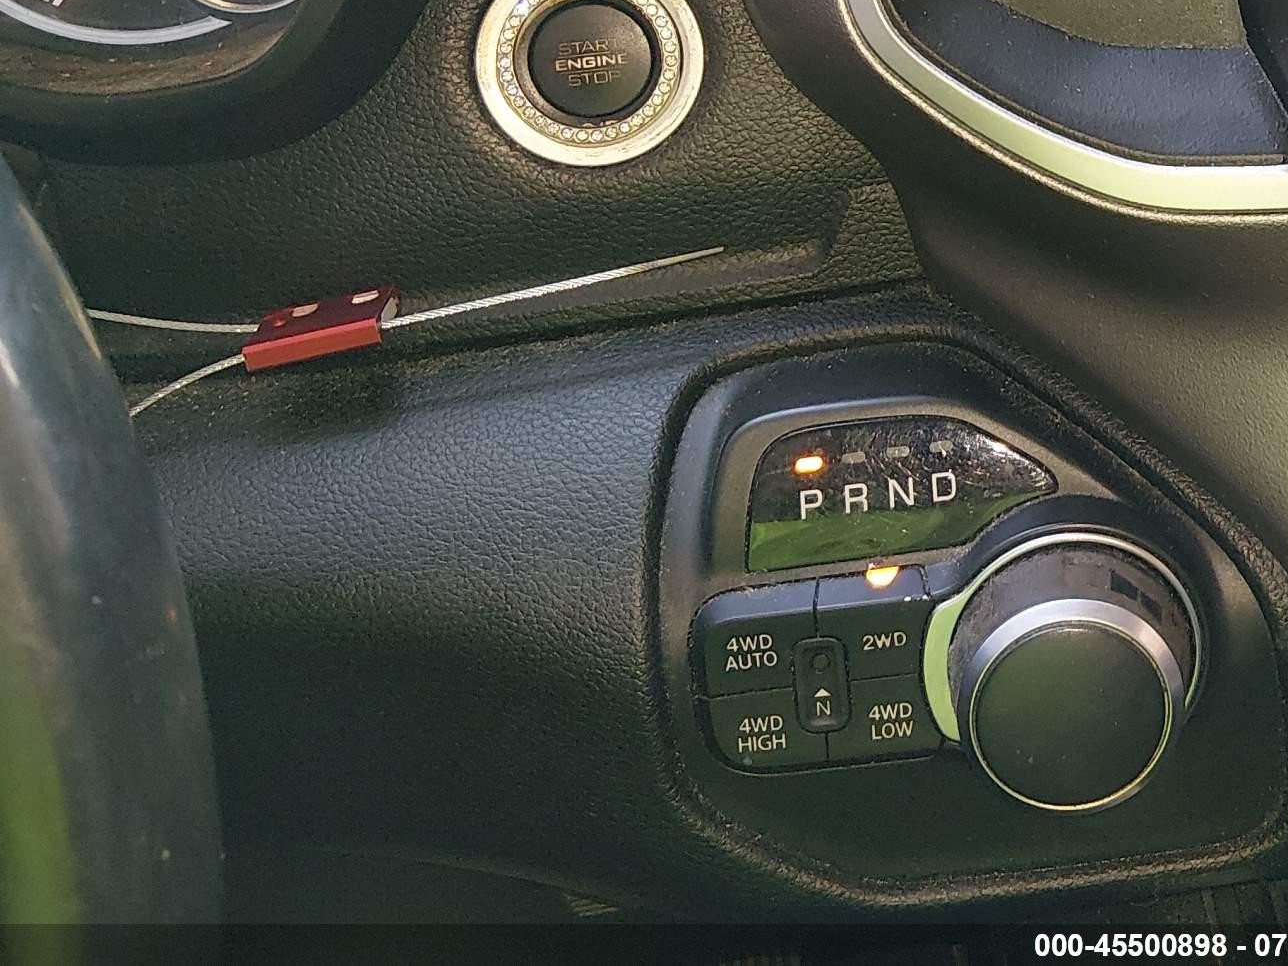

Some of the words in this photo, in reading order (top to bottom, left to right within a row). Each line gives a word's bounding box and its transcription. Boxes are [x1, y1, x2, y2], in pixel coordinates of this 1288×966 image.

[555, 52, 629, 72] ENGINE
[568, 69, 623, 88] STOP
[800, 489, 824, 520] P
[844, 483, 869, 515] R
[888, 476, 914, 509] N
[931, 471, 957, 504] D
[726, 634, 774, 652] 4WD
[862, 631, 907, 651] 2WD
[725, 650, 778, 672] AUTO
[816, 699, 831, 716] N
[868, 701, 913, 722] 4WD
[738, 714, 783, 734] 4WD
[871, 719, 914, 741] LOW
[738, 732, 787, 754] HIGH
